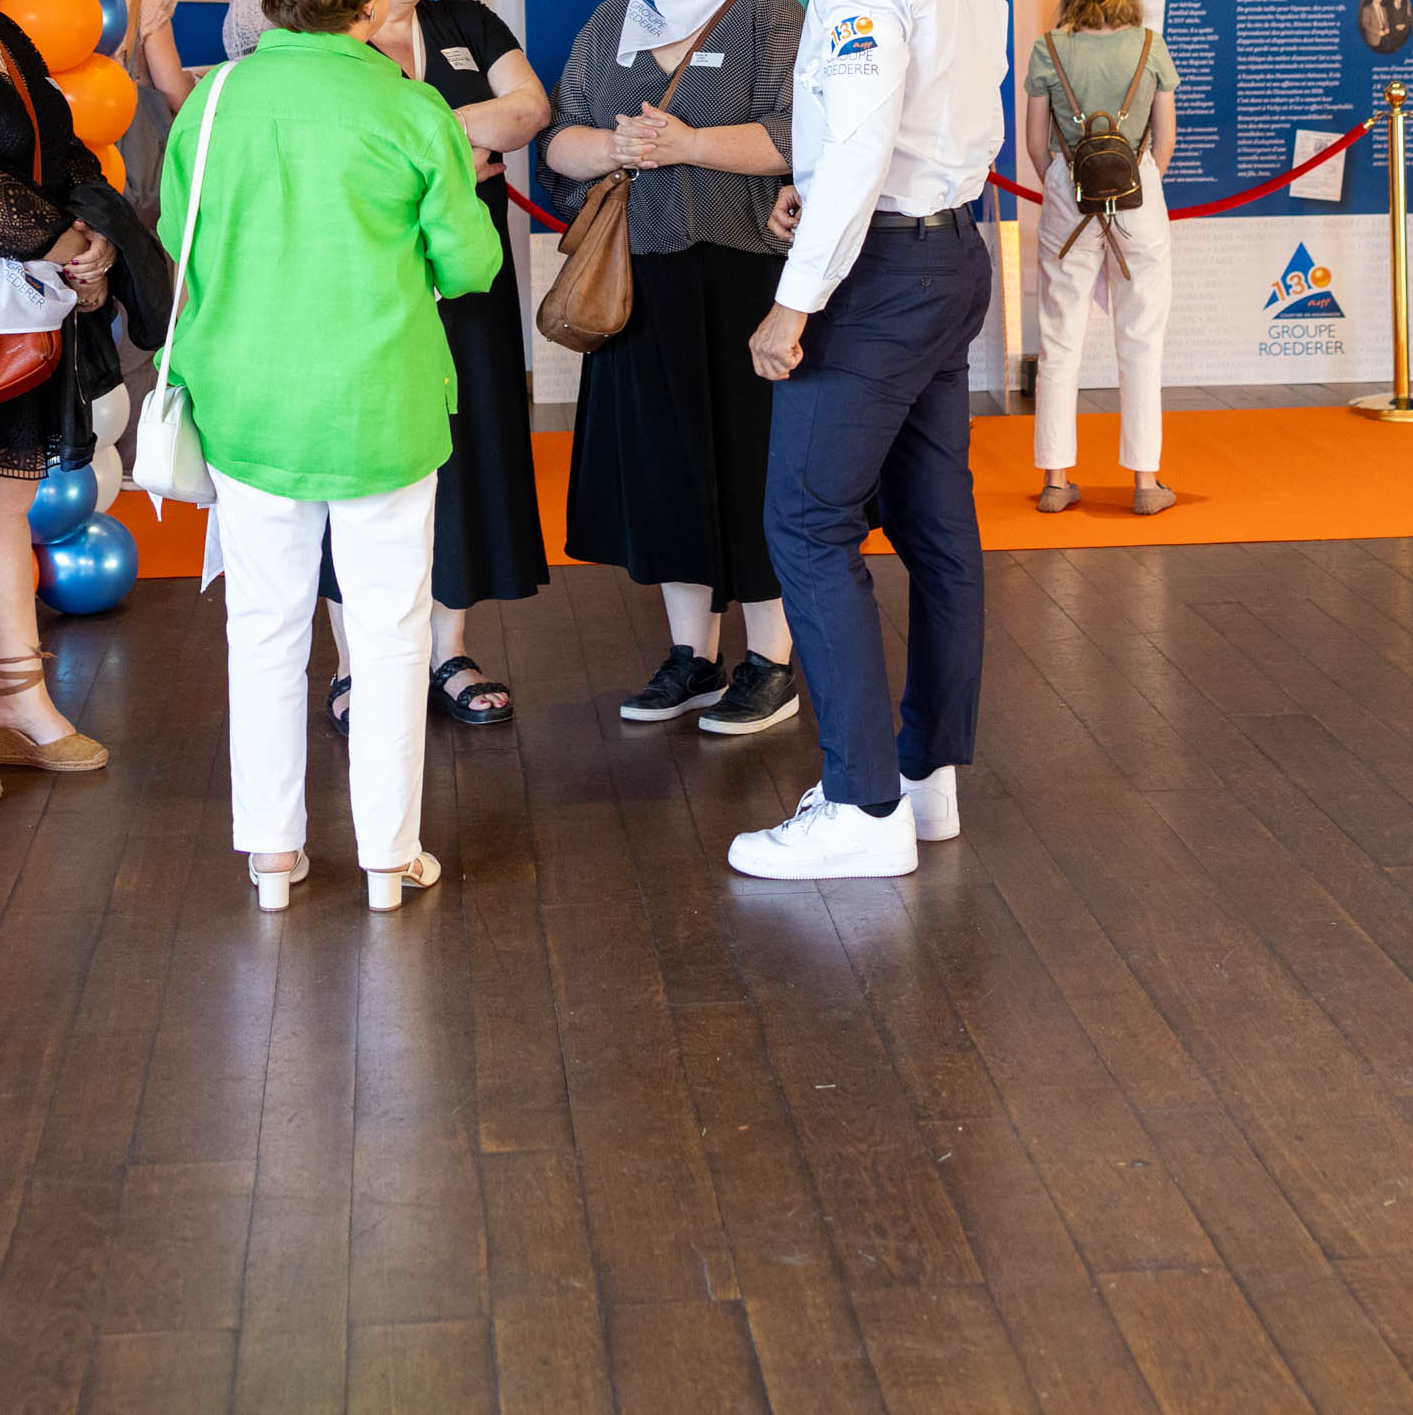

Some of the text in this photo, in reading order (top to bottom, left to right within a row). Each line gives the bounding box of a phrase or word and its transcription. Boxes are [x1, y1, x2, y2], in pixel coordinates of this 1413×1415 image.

[631, 1, 667, 29] GROUPE
[1271, 266, 1331, 301] 130
[1268, 324, 1336, 339] GROUPE
[1259, 341, 1344, 356] ROEDERER
